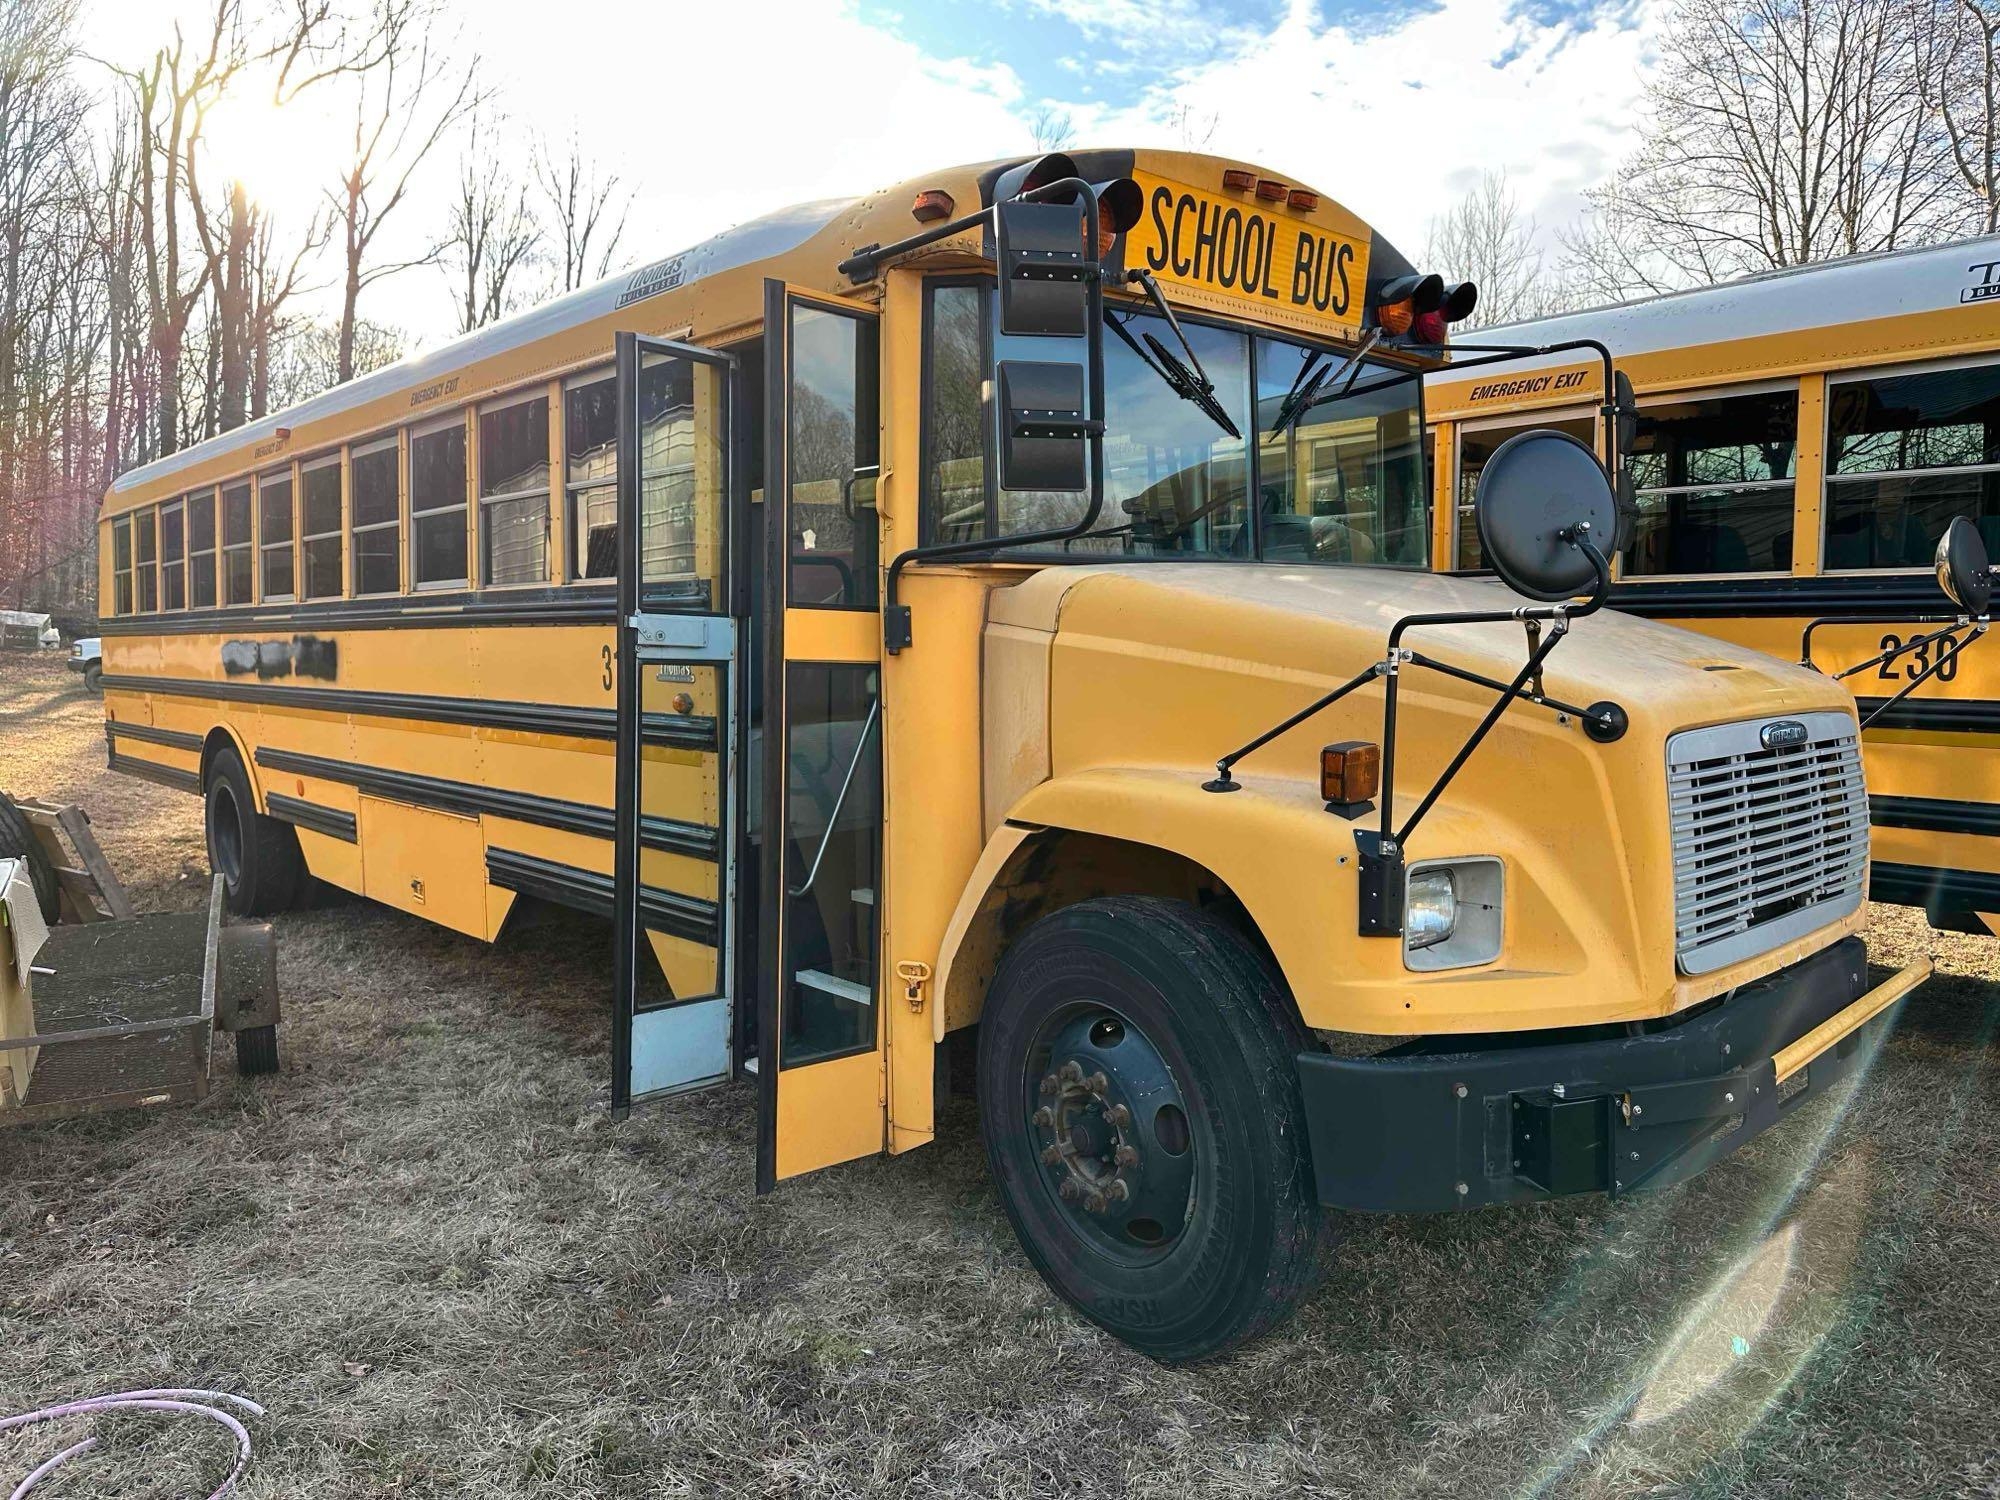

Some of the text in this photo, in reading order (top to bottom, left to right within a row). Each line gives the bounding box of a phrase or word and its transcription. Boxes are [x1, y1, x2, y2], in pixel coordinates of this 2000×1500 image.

[1146, 185, 1354, 317] SCHOOL BUS
[626, 255, 687, 291] Thomas
[1967, 261, 2000, 286] T
[621, 275, 679, 303] BUILT BUSES
[410, 382, 445, 407] EMERGENCY
[1469, 370, 1589, 401] EMERGENCY EXIT
[1878, 634, 1959, 682] 230
